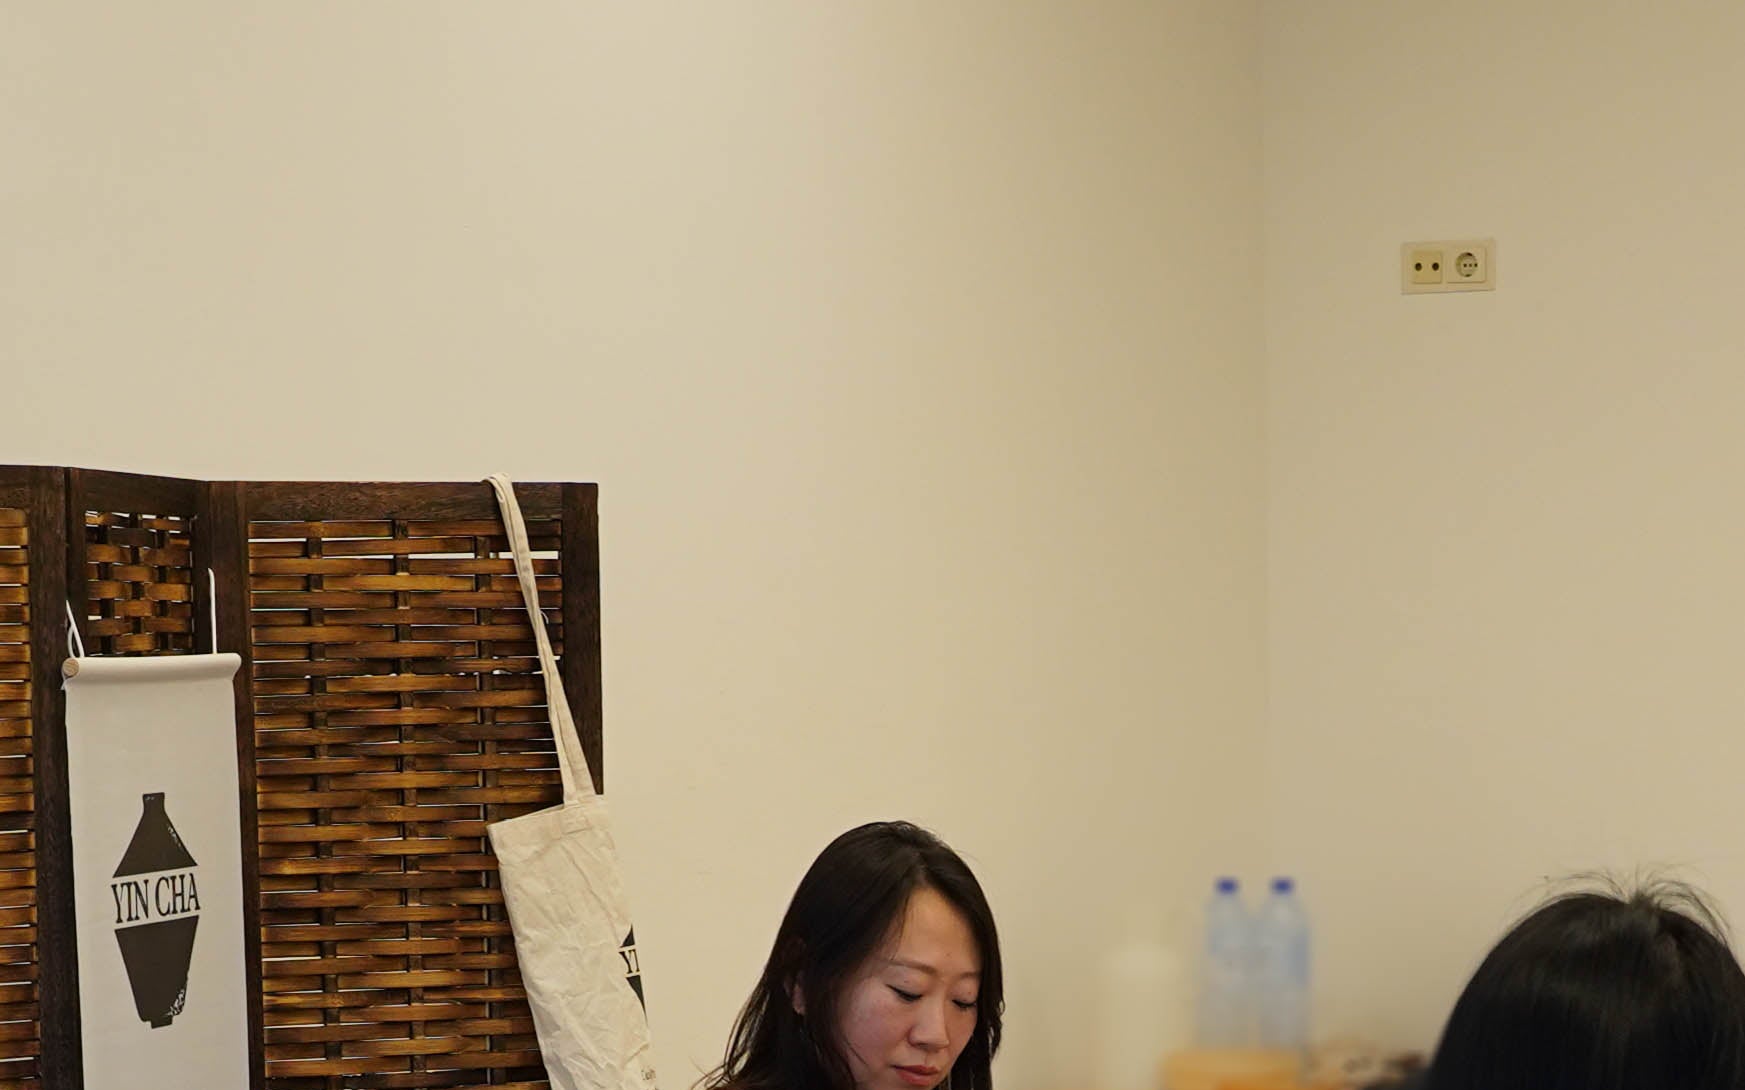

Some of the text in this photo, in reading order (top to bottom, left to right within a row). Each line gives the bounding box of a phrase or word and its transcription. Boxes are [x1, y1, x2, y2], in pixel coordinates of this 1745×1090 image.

[111, 873, 201, 924] YIN CHA
[618, 948, 641, 974] YI
